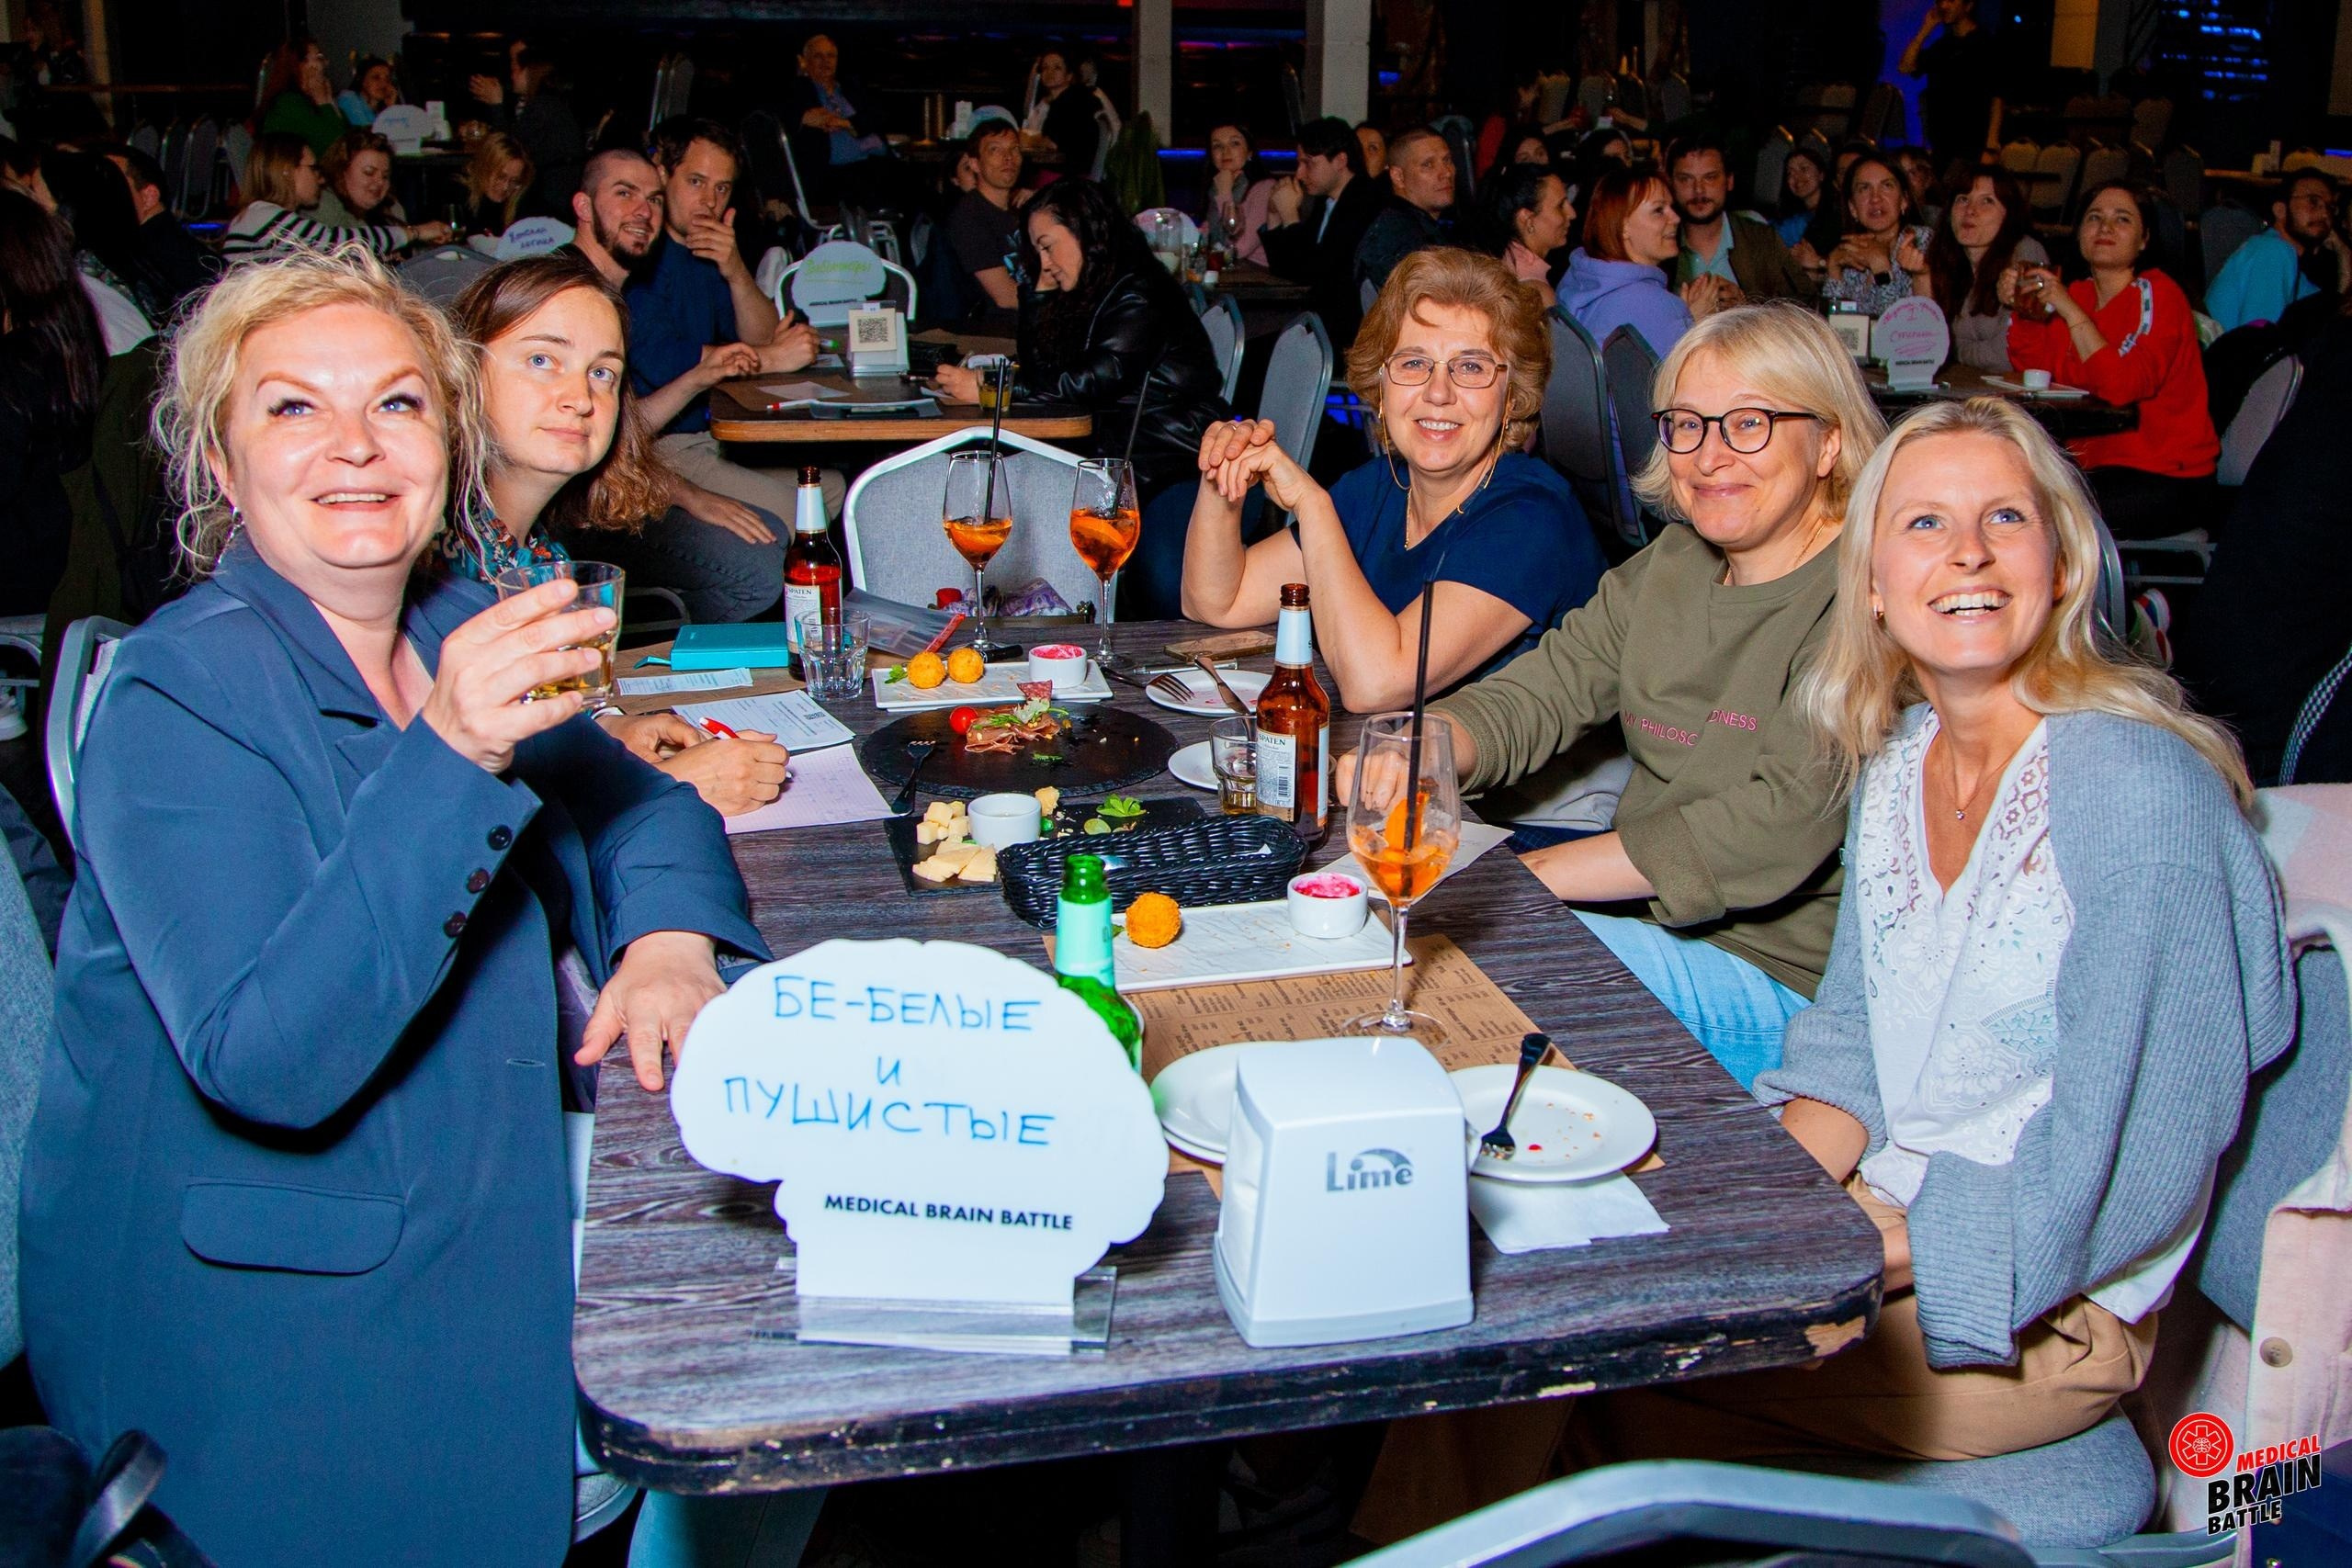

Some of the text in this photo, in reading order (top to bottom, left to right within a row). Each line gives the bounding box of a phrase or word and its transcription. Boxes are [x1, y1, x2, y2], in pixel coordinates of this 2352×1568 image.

[1623, 709, 1638, 727] MY
[1705, 709, 1758, 731] DNESS
[1259, 734, 1286, 746] SPATEN
[774, 975, 1042, 1031] БЕ-БЕЛЫЕ
[724, 1077, 1057, 1145] ПУШИСТЫЕ
[1327, 1149, 1412, 1191] Lime
[825, 1194, 1073, 1231] MEDICAL BRAIN BATTLE
